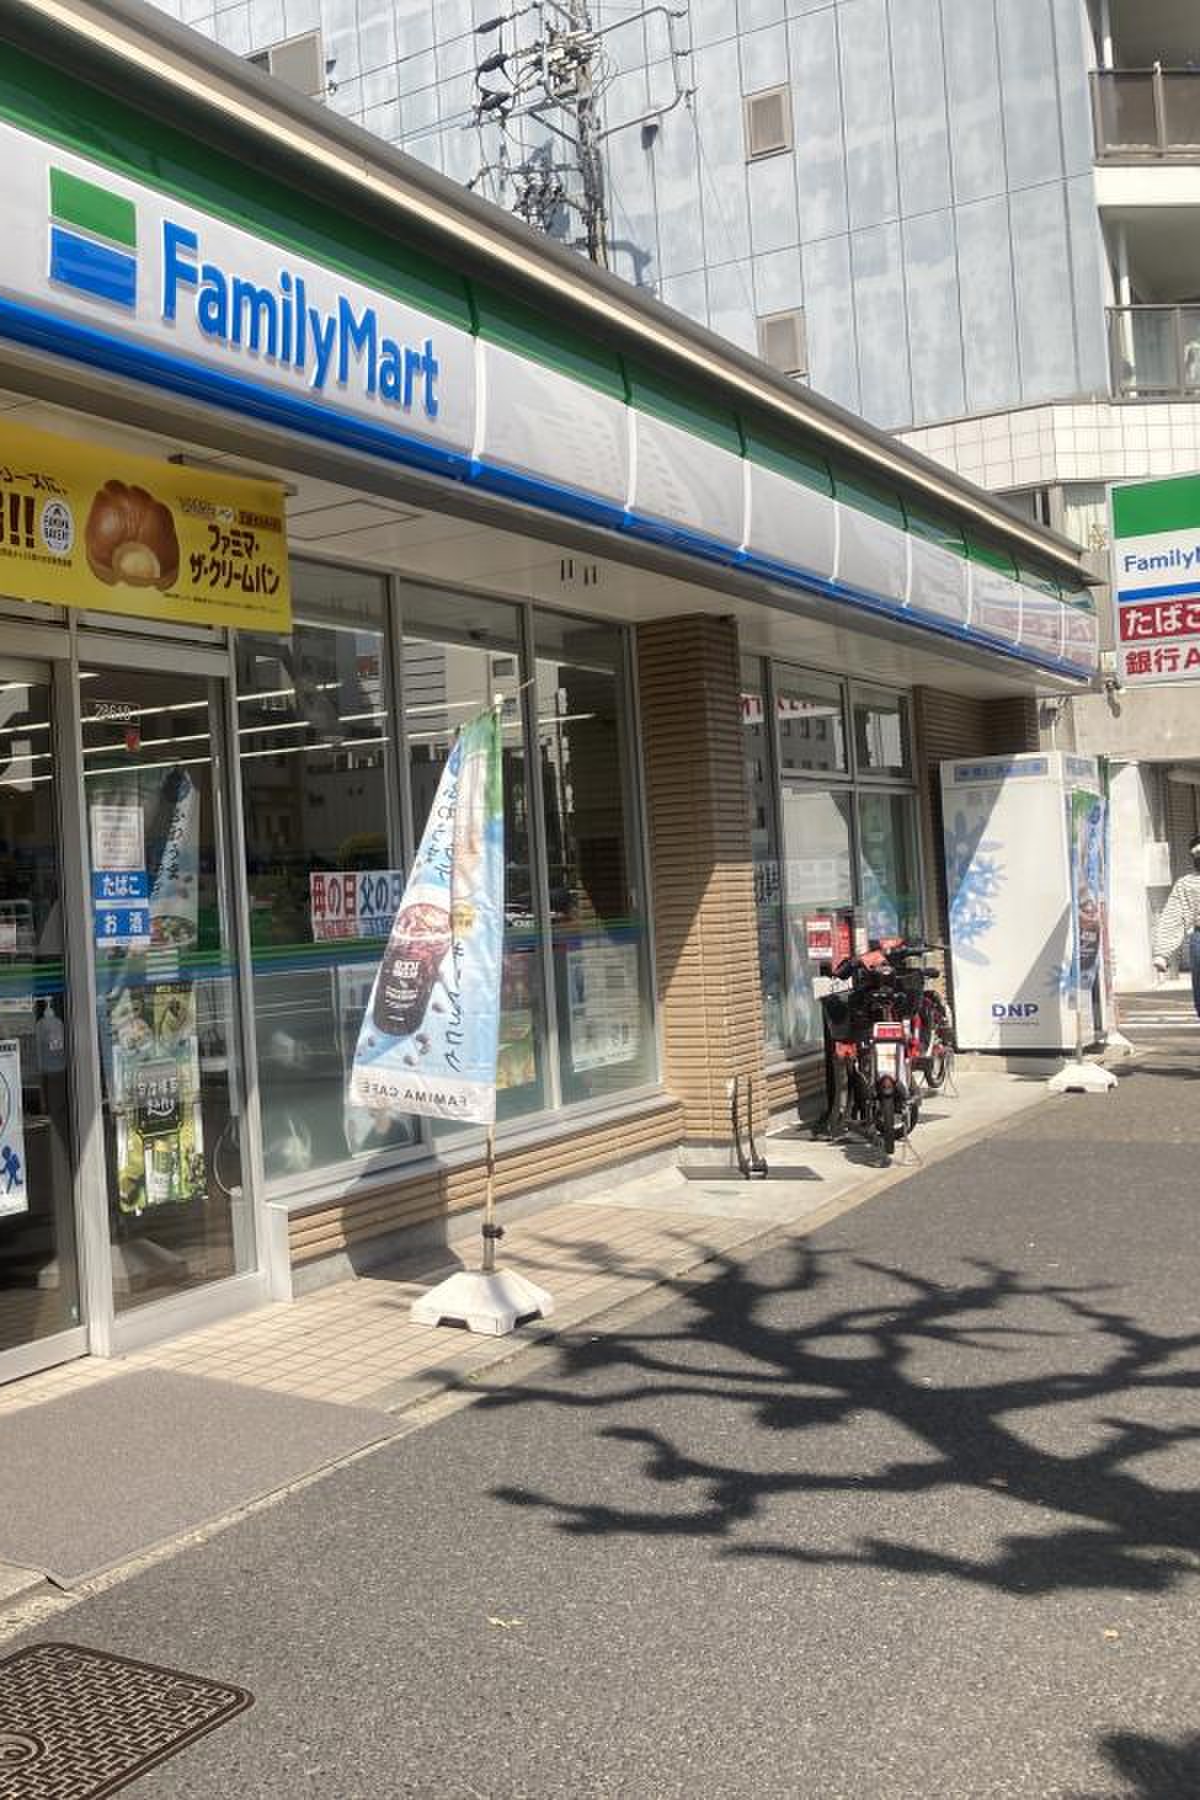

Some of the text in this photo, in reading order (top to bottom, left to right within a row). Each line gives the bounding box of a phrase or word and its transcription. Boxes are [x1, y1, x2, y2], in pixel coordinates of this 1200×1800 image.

[162, 219, 439, 418] FamilyMart
[102, 874, 141, 897] たばこ
[992, 1003, 1039, 1017] DNP
